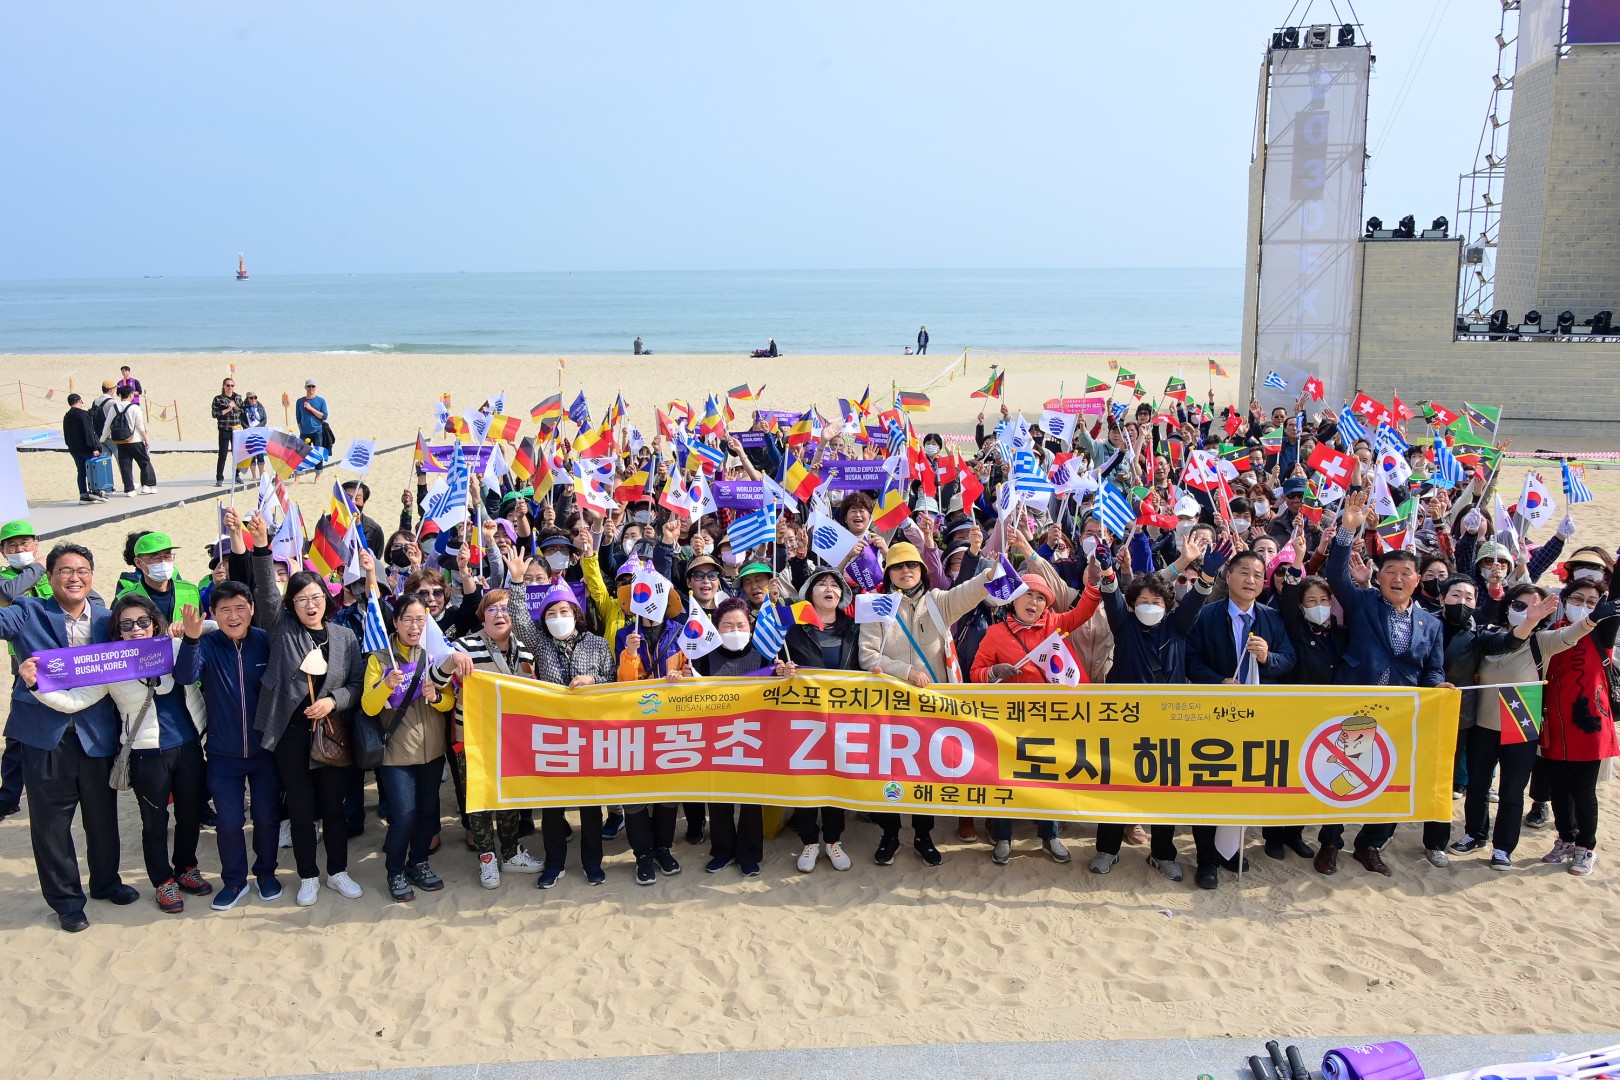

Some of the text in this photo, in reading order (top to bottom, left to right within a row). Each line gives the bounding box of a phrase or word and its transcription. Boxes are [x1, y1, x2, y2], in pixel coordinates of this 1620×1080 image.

[73, 648, 139, 664] WORLD EXPO 2030
[75, 664, 104, 675] BUSAN,
[104, 661, 127, 671] KOREA
[694, 694, 717, 702] EXPO
[718, 693, 740, 701] 2030
[762, 685, 1140, 723] 엑스포 유치기원 함께하는 쾌적도시 조성
[675, 703, 731, 712] BUSAN, KOREA
[530, 718, 1290, 788] 담배꽁초 ZERO 도시 해운대
